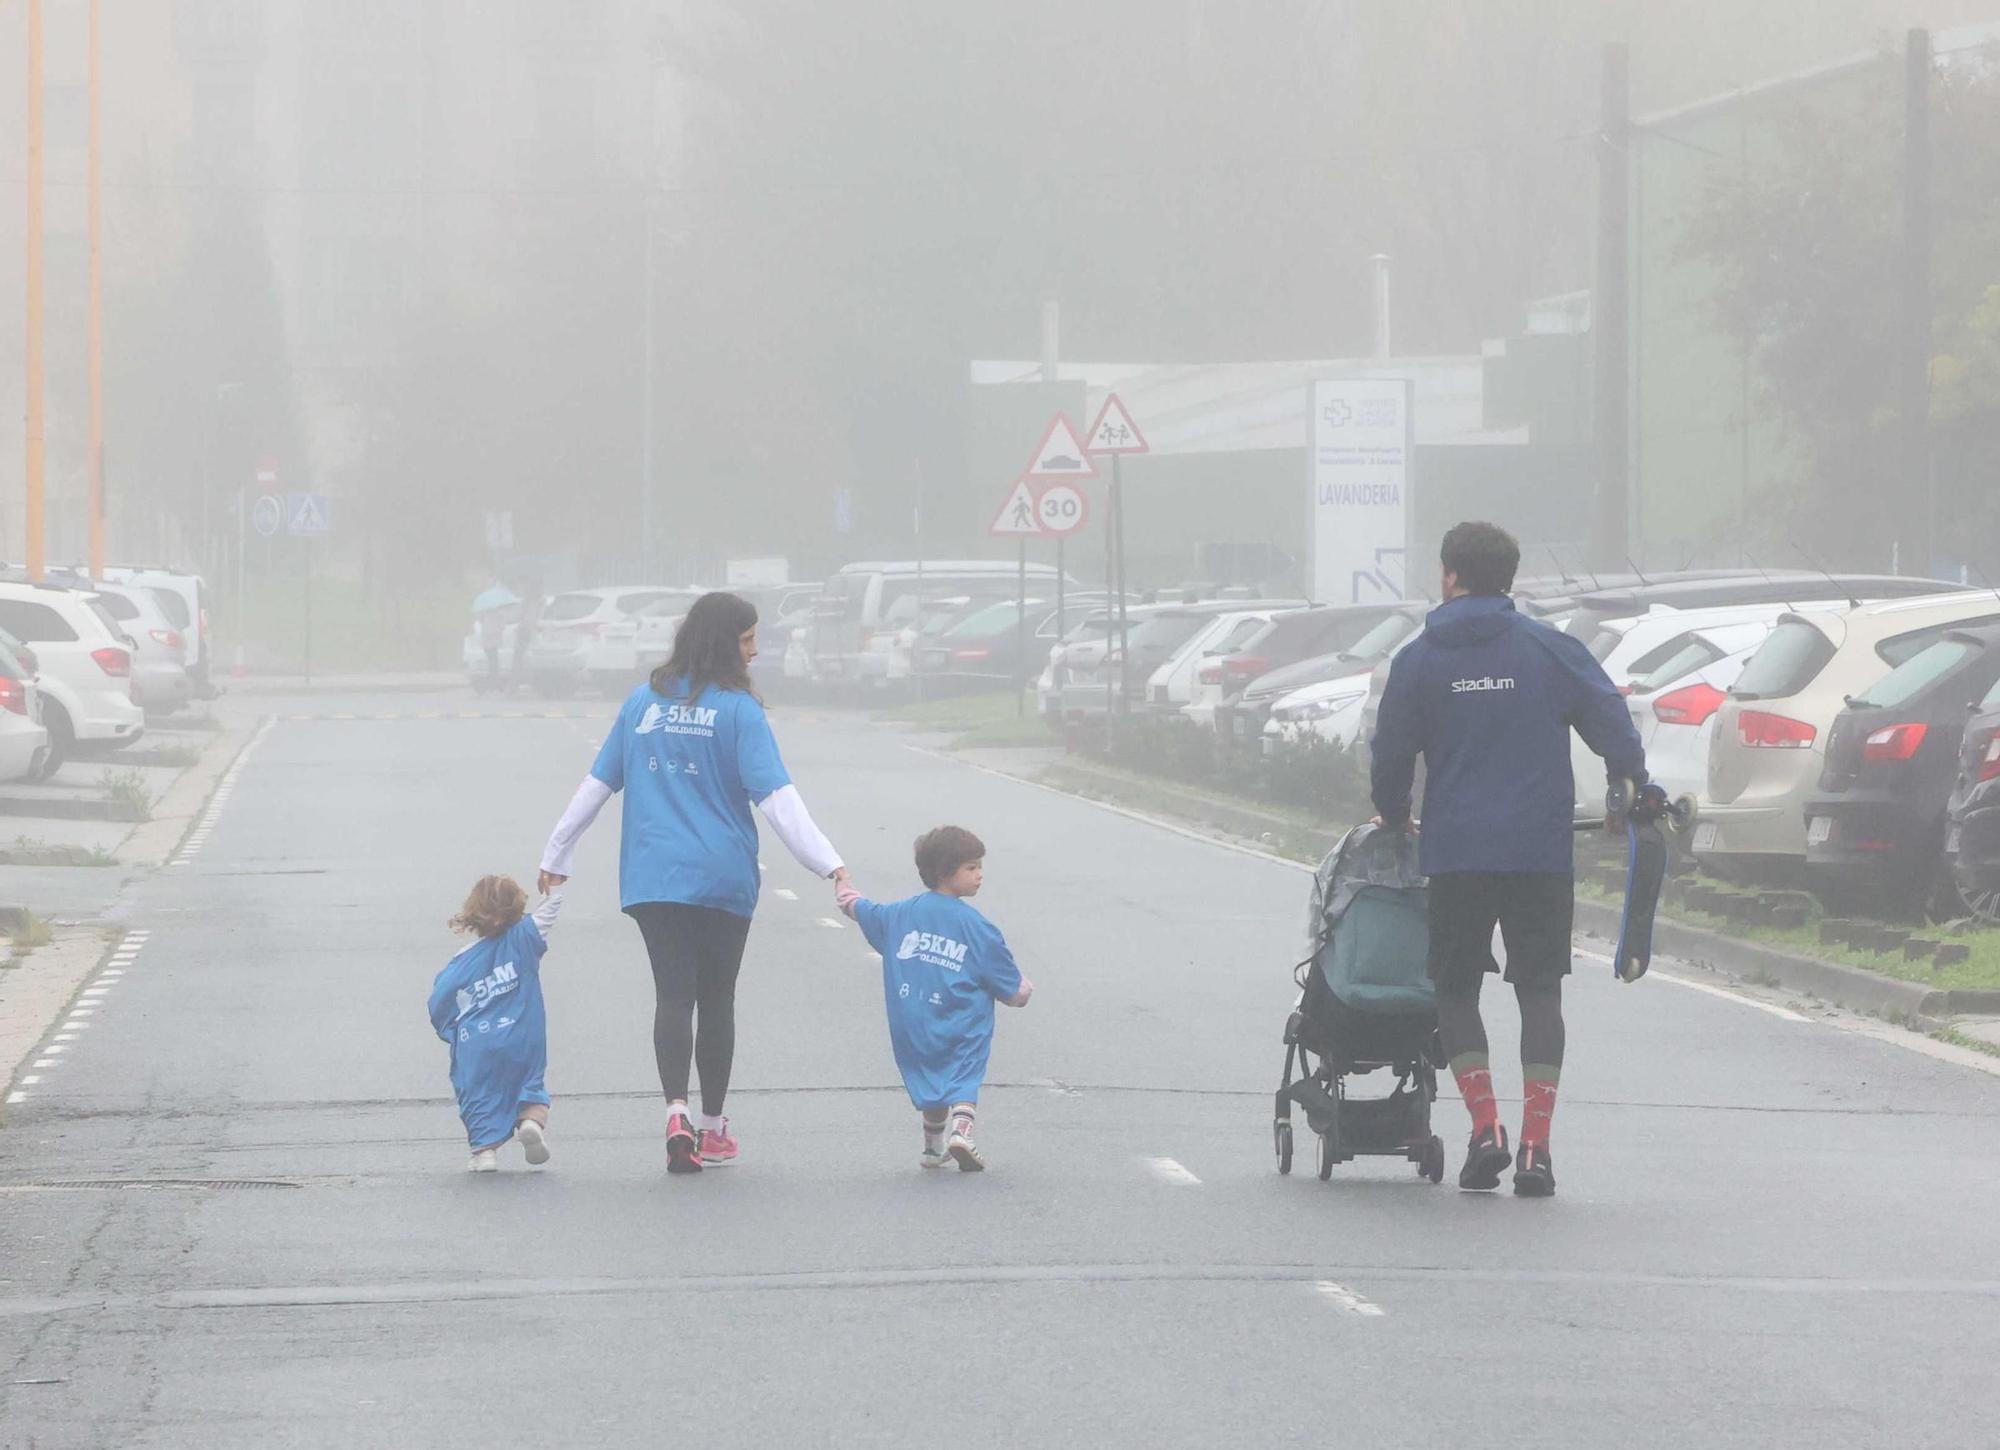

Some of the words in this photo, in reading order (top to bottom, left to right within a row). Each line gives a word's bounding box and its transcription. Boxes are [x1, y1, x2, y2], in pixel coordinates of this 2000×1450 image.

[1045, 499, 1077, 517] 30
[1451, 676, 1514, 692] stadium
[666, 705, 718, 727] 5KM
[664, 725, 714, 737] SOLIDARIOS
[919, 932, 968, 963] 5KM
[920, 953, 962, 973] OLIDARIOS
